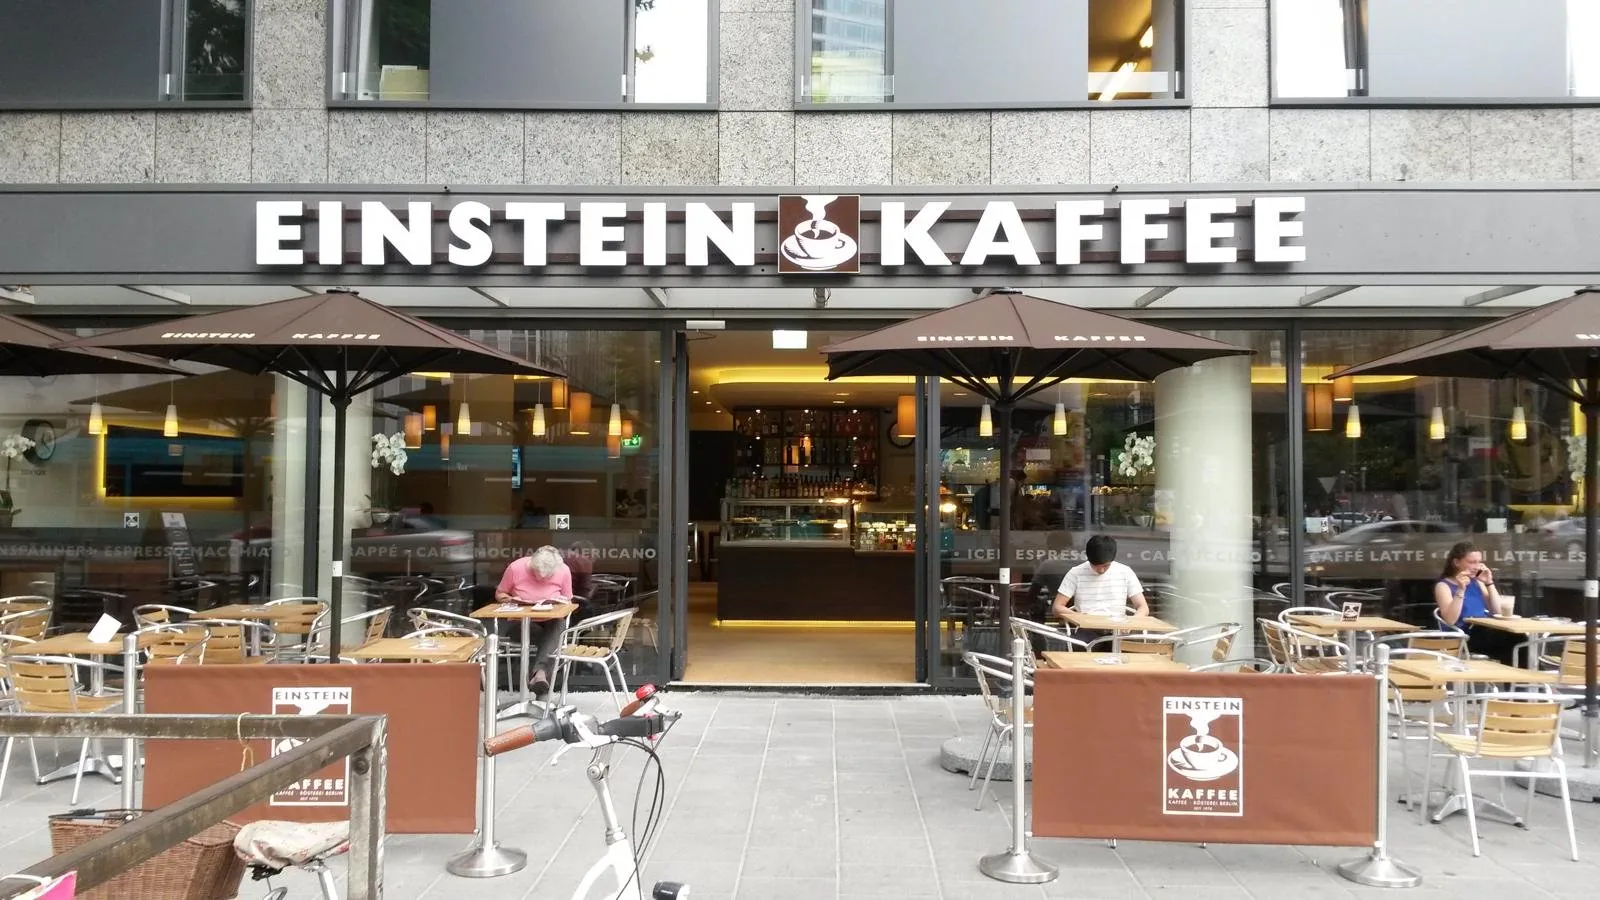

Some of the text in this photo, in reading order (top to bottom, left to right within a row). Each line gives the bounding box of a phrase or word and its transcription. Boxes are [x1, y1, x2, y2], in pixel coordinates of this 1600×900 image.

[256, 196, 1307, 267] EINSTEIN KAFFEE
[967, 548, 1001, 560] ICE
[1015, 549, 1089, 561] ESPRESS
[1370, 550, 1425, 562] LATTE
[1493, 551, 1549, 562] LATTE
[275, 691, 349, 701] EINSTEIN
[1165, 700, 1240, 711] EINSTEIN
[288, 778, 345, 790] AFFEE
[1168, 788, 1238, 800] KAFFEE
